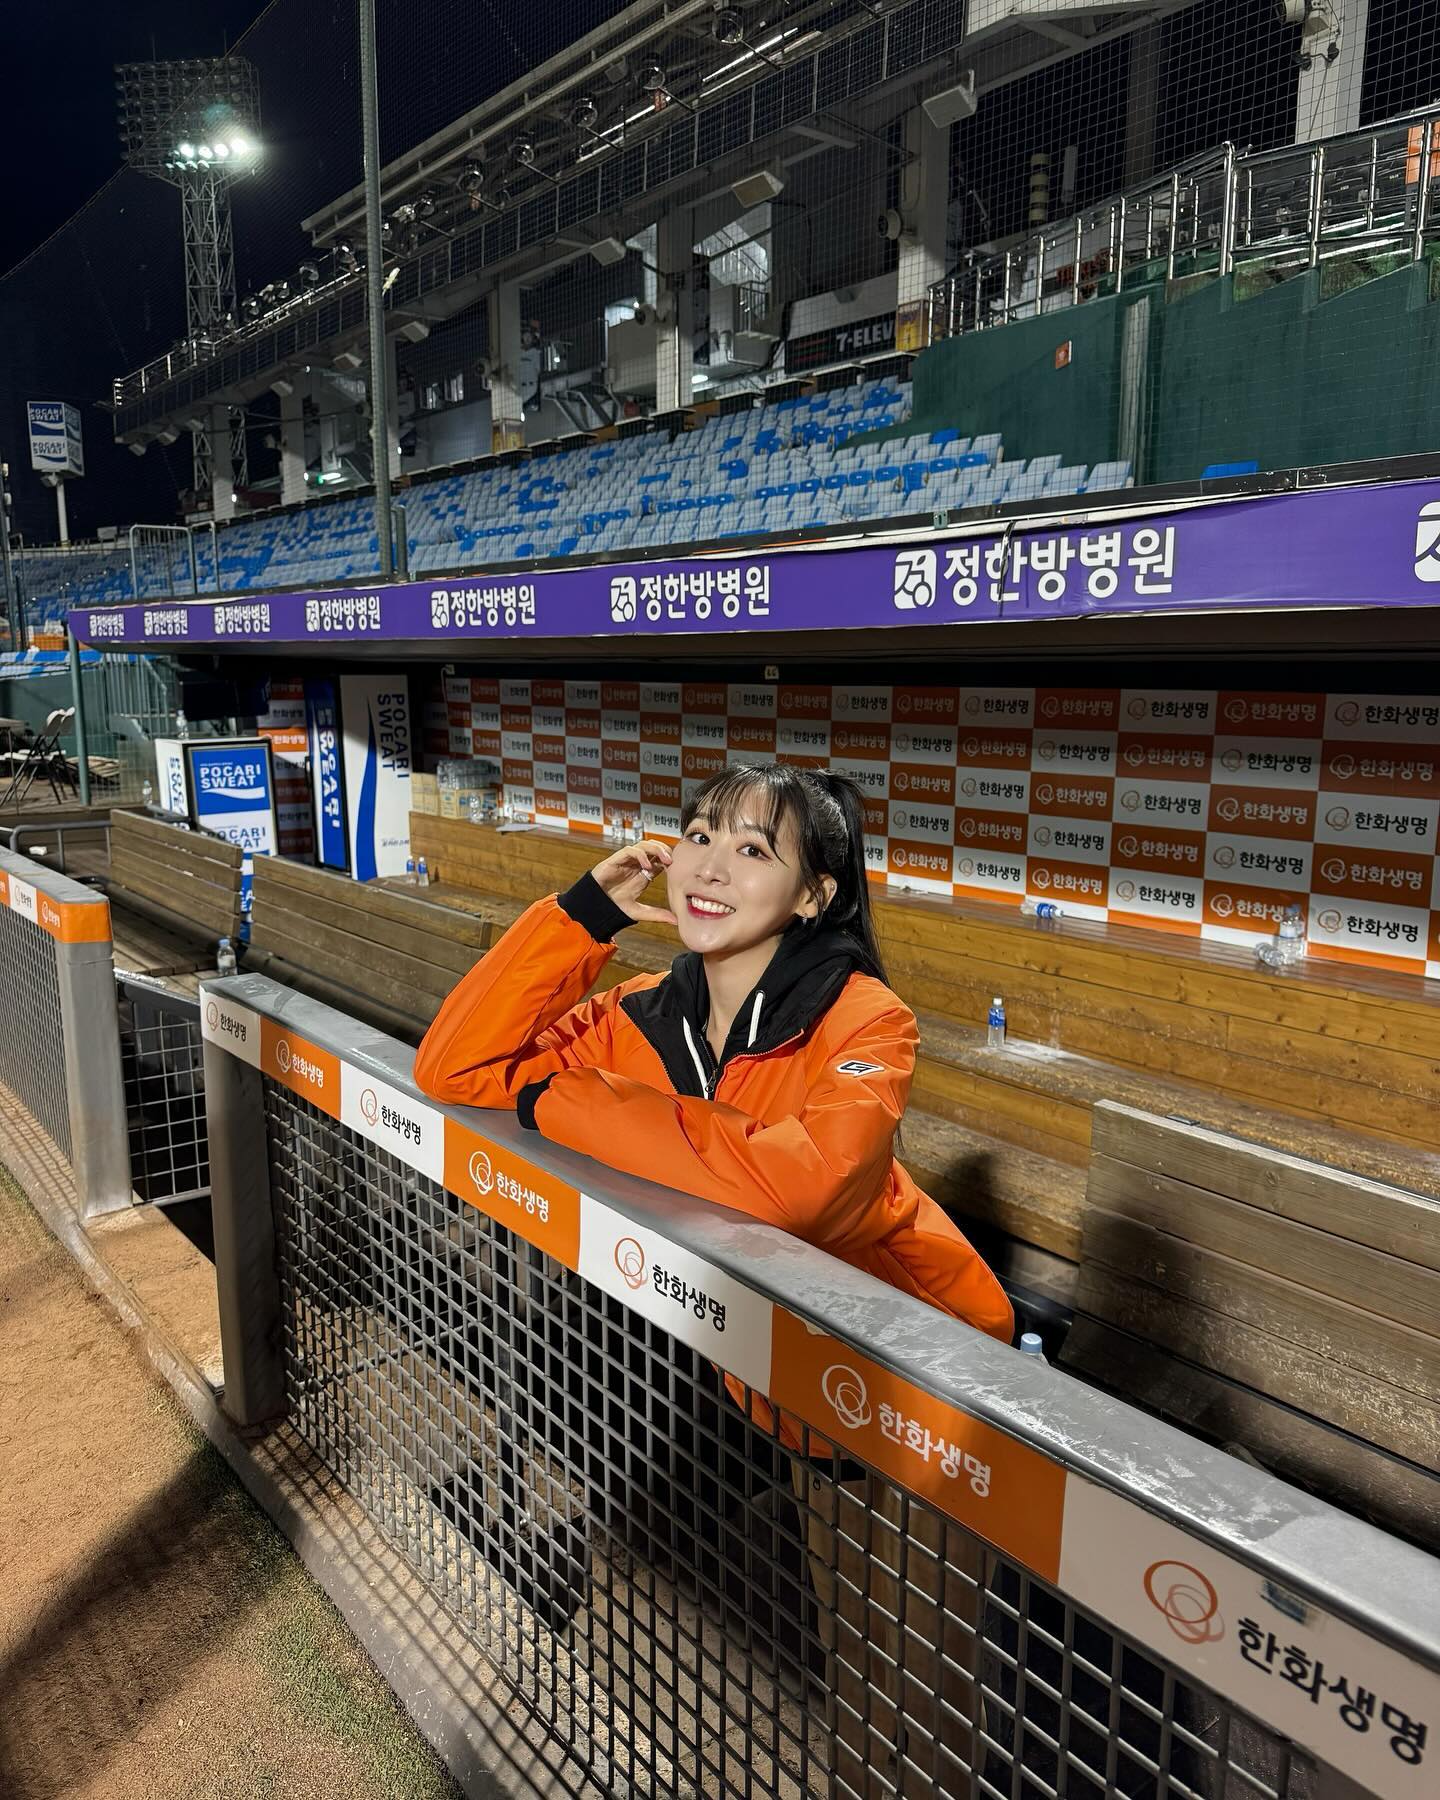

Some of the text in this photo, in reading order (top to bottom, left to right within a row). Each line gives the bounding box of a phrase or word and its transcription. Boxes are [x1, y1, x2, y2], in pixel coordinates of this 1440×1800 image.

[943, 526, 1176, 608] 정한방병원
[639, 565, 771, 619] 정한방병원
[320, 591, 381, 632] 정한방병원
[450, 585, 537, 628] 정한방병원
[153, 609, 188, 635] 정한방병원
[225, 603, 270, 633] 정한방병원
[653, 690, 681, 703] 한화생명
[743, 694, 774, 706] 한화생명
[851, 696, 888, 711] 한화생명
[912, 695, 954, 713] 한화생명
[983, 696, 1029, 714] 한화생명
[1061, 698, 1113, 717] 한화생명
[1150, 700, 1209, 720] 한화생명
[1250, 701, 1317, 722] 한화생명
[1364, 703, 1440, 728] 한화생명
[377, 694, 396, 772] SWEAT
[391, 694, 410, 778] POCARI
[696, 725, 724, 738] 한화생명
[793, 731, 826, 746] 한화생명
[850, 733, 887, 749] 한화생명
[911, 737, 952, 753] 한화생명
[981, 741, 1027, 758] 한화생명
[1059, 743, 1111, 762] 한화생명
[654, 754, 679, 768] 한화생명
[1146, 747, 1206, 769] 한화생명
[1246, 751, 1313, 773] 한화생명
[200, 763, 261, 779] POCARI
[1358, 757, 1435, 782] 한화생명
[200, 774, 257, 790] SWEAT
[614, 780, 638, 794] 한화생명
[910, 776, 951, 793] 한화생명
[979, 782, 1024, 799] 한화생명
[1056, 787, 1108, 807] 한화생명
[1144, 794, 1202, 815] 한화생명
[654, 815, 680, 829] 한화생명
[909, 814, 950, 832] 한화생명
[1242, 802, 1308, 825] 한화생명
[1354, 811, 1428, 837] 한화생명
[209, 827, 266, 841] OCARI
[978, 822, 1023, 841] 한화생명
[1054, 830, 1105, 851] 한화생명
[1140, 841, 1199, 863] 한화생명
[1239, 850, 1304, 875] 한화생명
[906, 855, 949, 873] 한화생명
[976, 863, 1021, 882] 한화생명
[1051, 873, 1103, 896] 한화생명
[1349, 863, 1424, 891] 한화생명
[1138, 886, 1196, 909] 한화생명
[1235, 899, 1284, 923] 한화생
[1345, 914, 1420, 944] 한화생명
[219, 1012, 247, 1043] 한화생명
[291, 1054, 324, 1089] 한화생명
[380, 1105, 422, 1147] 한화생명
[495, 1170, 550, 1225] 한화생명
[652, 1263, 727, 1335] 한화생명
[877, 1400, 992, 1499] 한화생명
[1236, 1615, 1429, 1768] 한화생명
